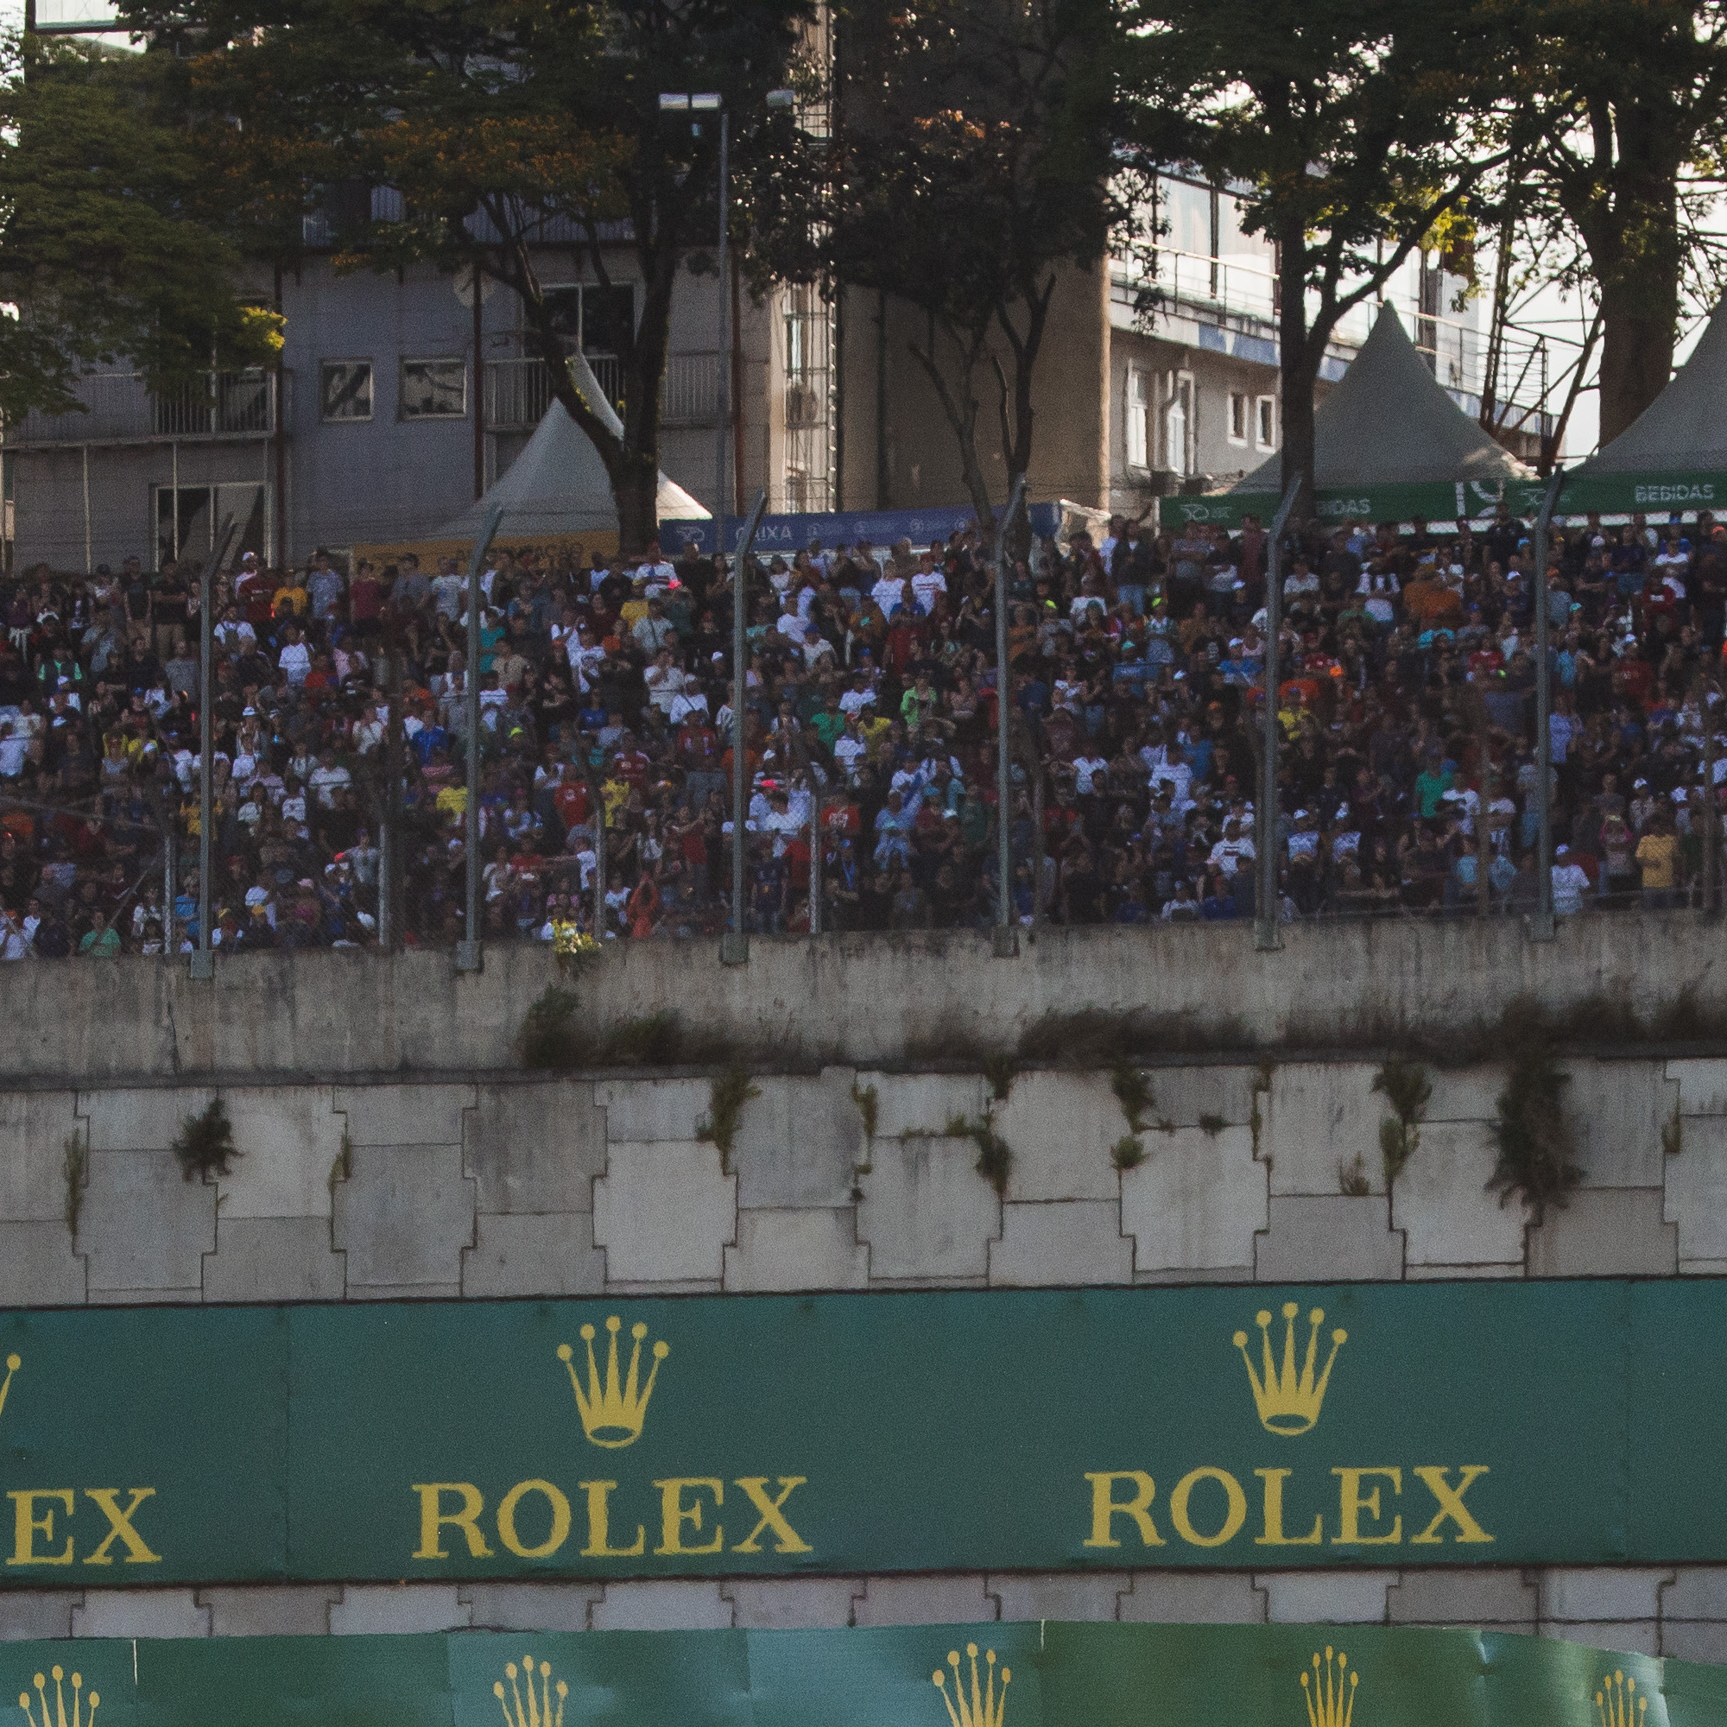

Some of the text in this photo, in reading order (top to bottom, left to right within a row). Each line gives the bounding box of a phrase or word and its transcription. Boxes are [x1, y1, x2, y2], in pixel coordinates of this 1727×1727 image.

[1635, 484, 1715, 503] BEBIDAS
[412, 1477, 812, 1558] ROLEX
[1084, 1466, 1494, 1547] ROLEX
